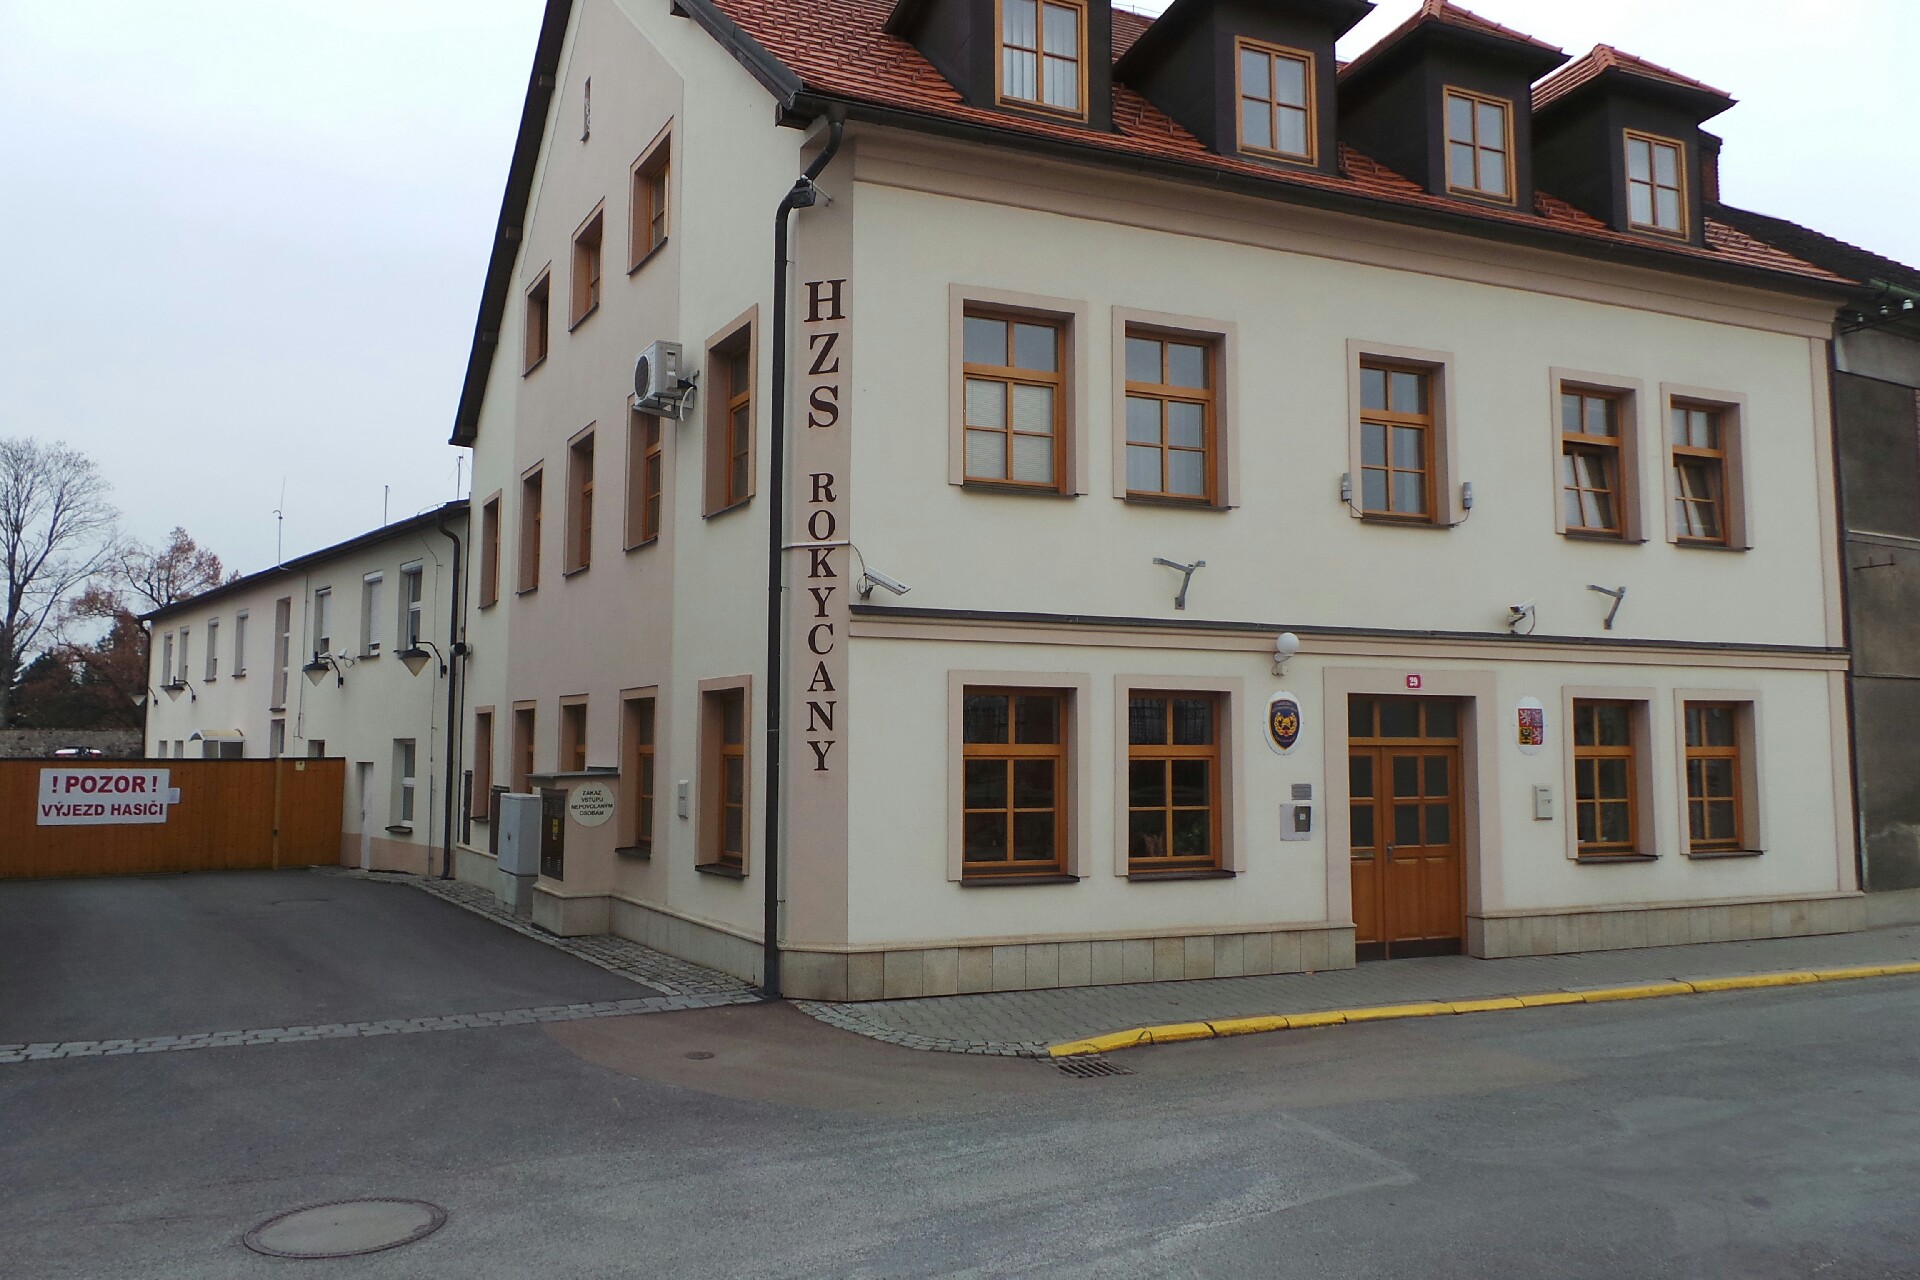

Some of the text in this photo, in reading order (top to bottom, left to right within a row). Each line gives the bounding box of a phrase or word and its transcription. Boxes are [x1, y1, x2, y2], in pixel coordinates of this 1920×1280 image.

[803, 278, 847, 772] HZS ROKYCANY
[64, 775, 146, 794] POZOR
[41, 801, 164, 817] VÝJEZD HASIČI
